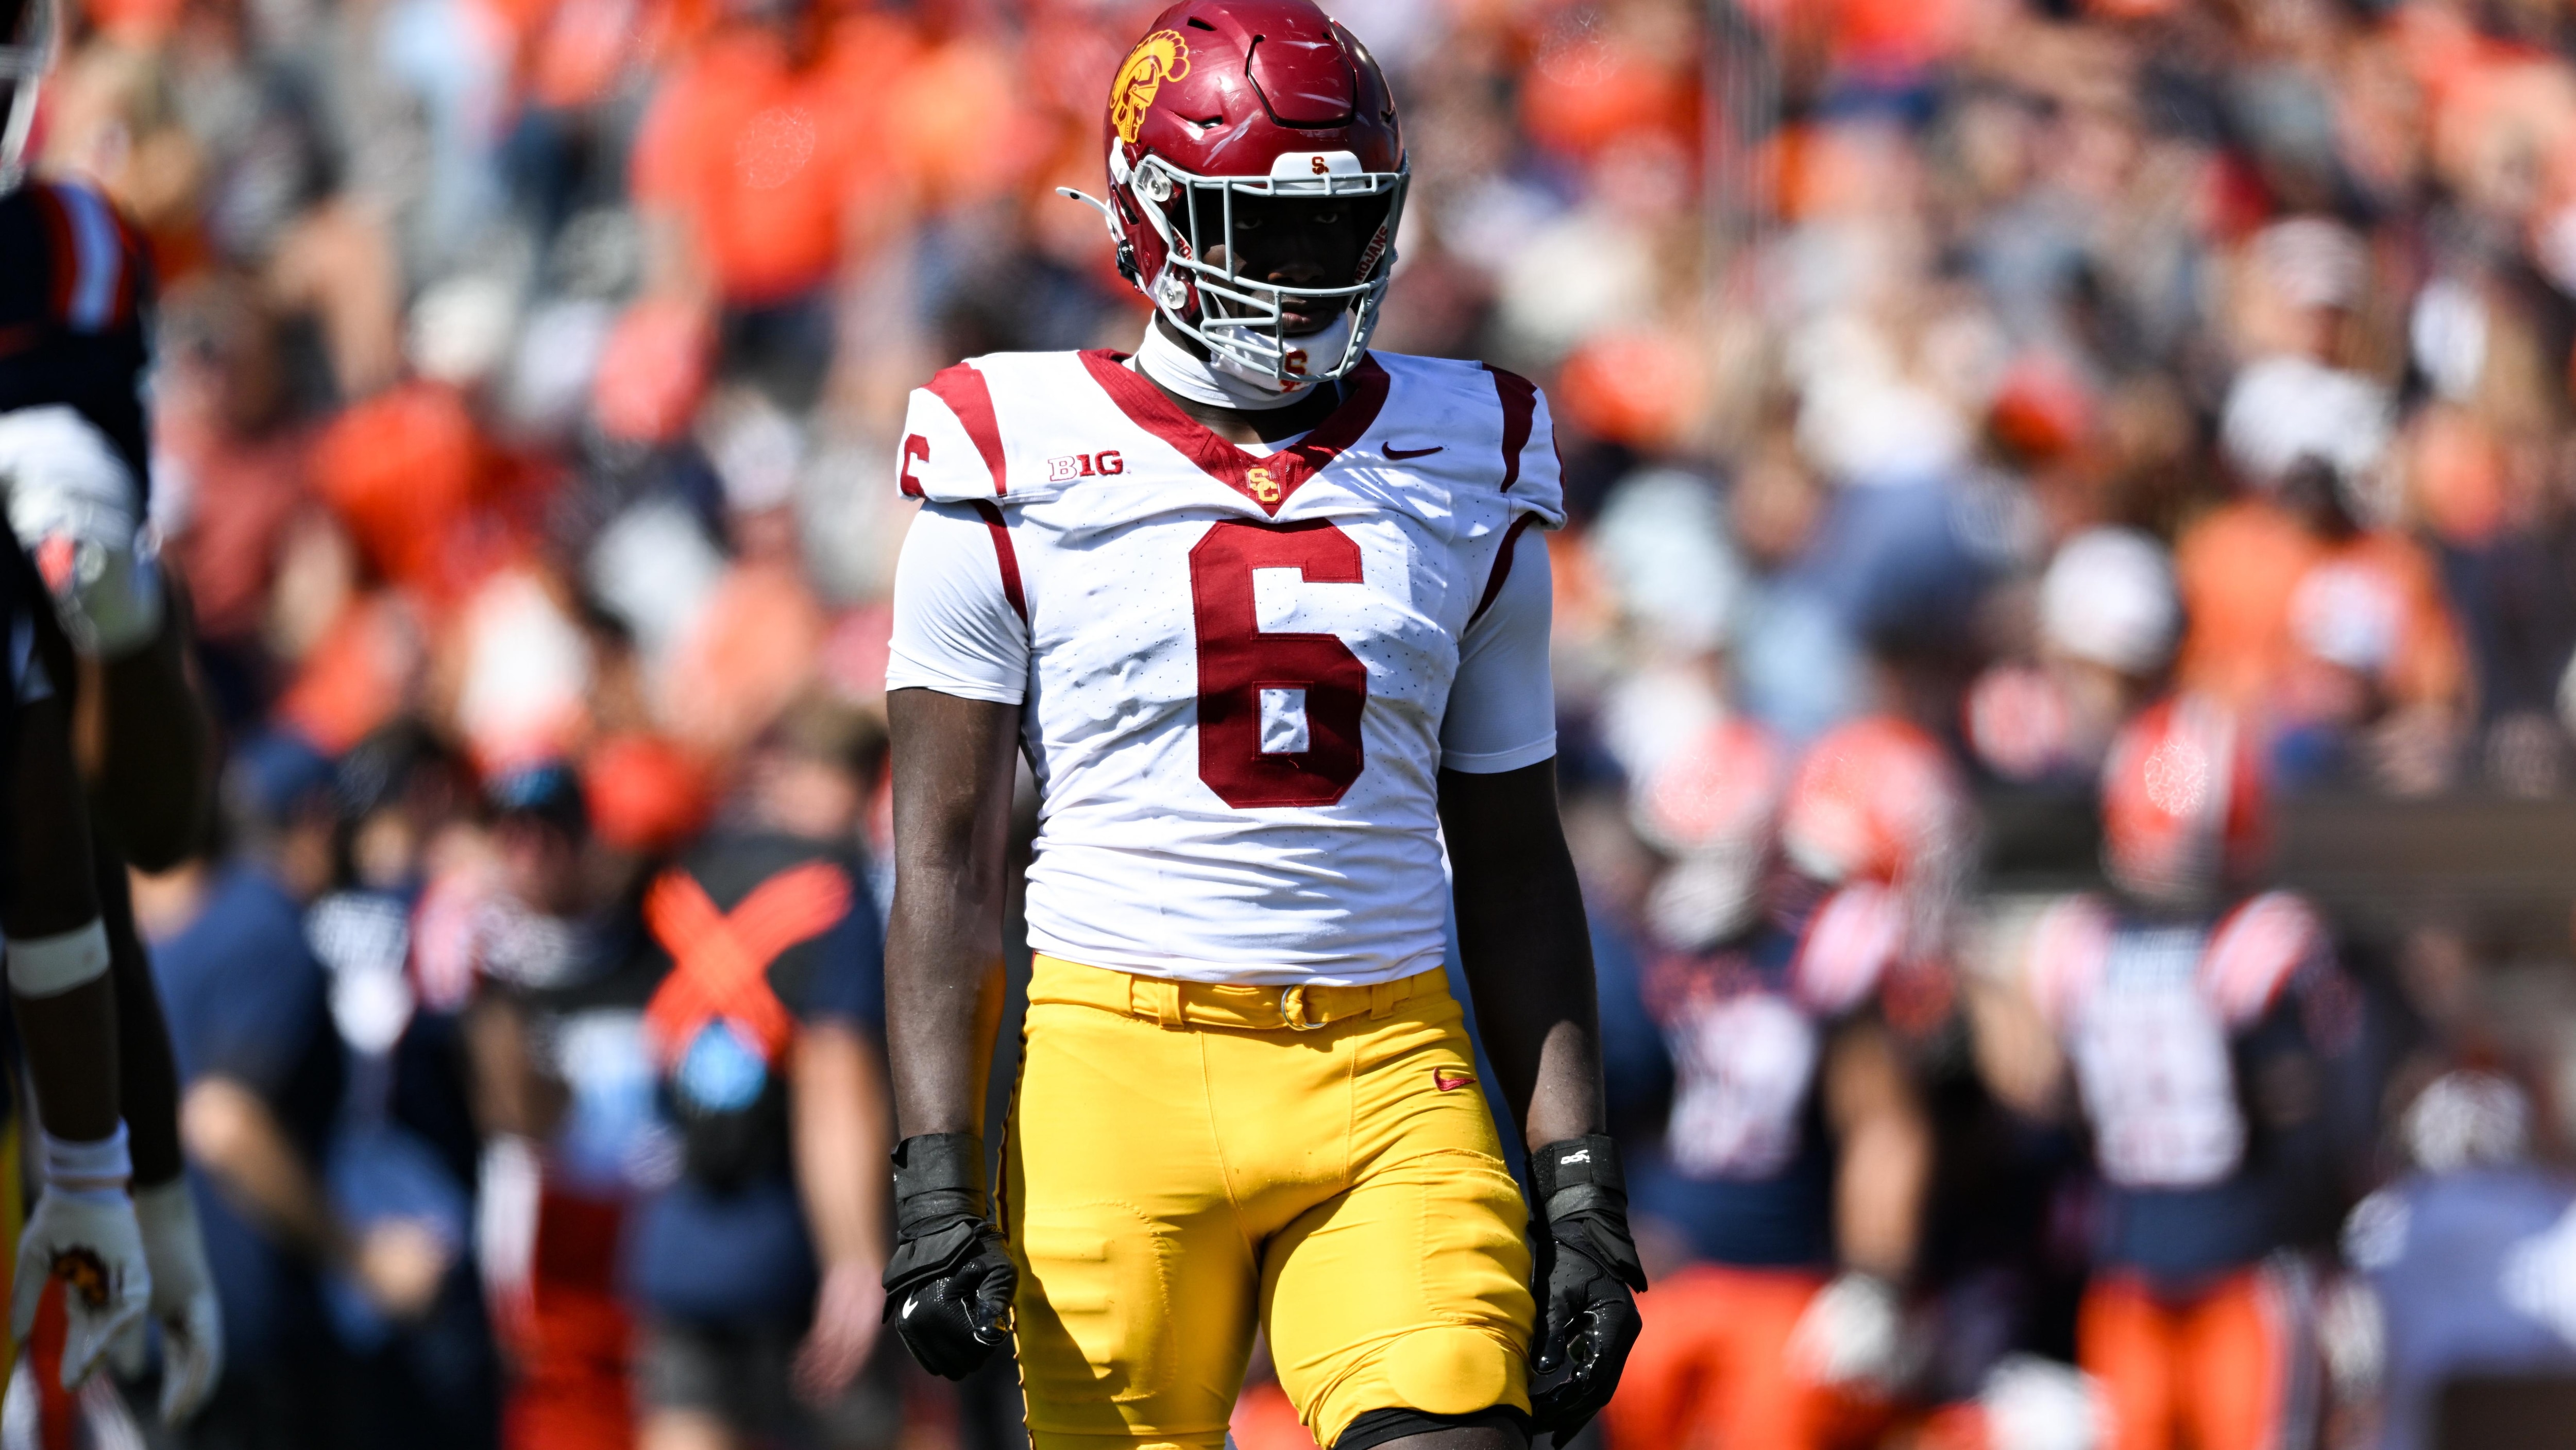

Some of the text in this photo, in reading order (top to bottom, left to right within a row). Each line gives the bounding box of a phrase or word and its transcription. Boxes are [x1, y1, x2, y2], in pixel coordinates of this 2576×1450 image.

[1352, 225, 1388, 283] ROJANS
[1247, 468, 1279, 502] SC
[1189, 517, 1367, 809] 6
